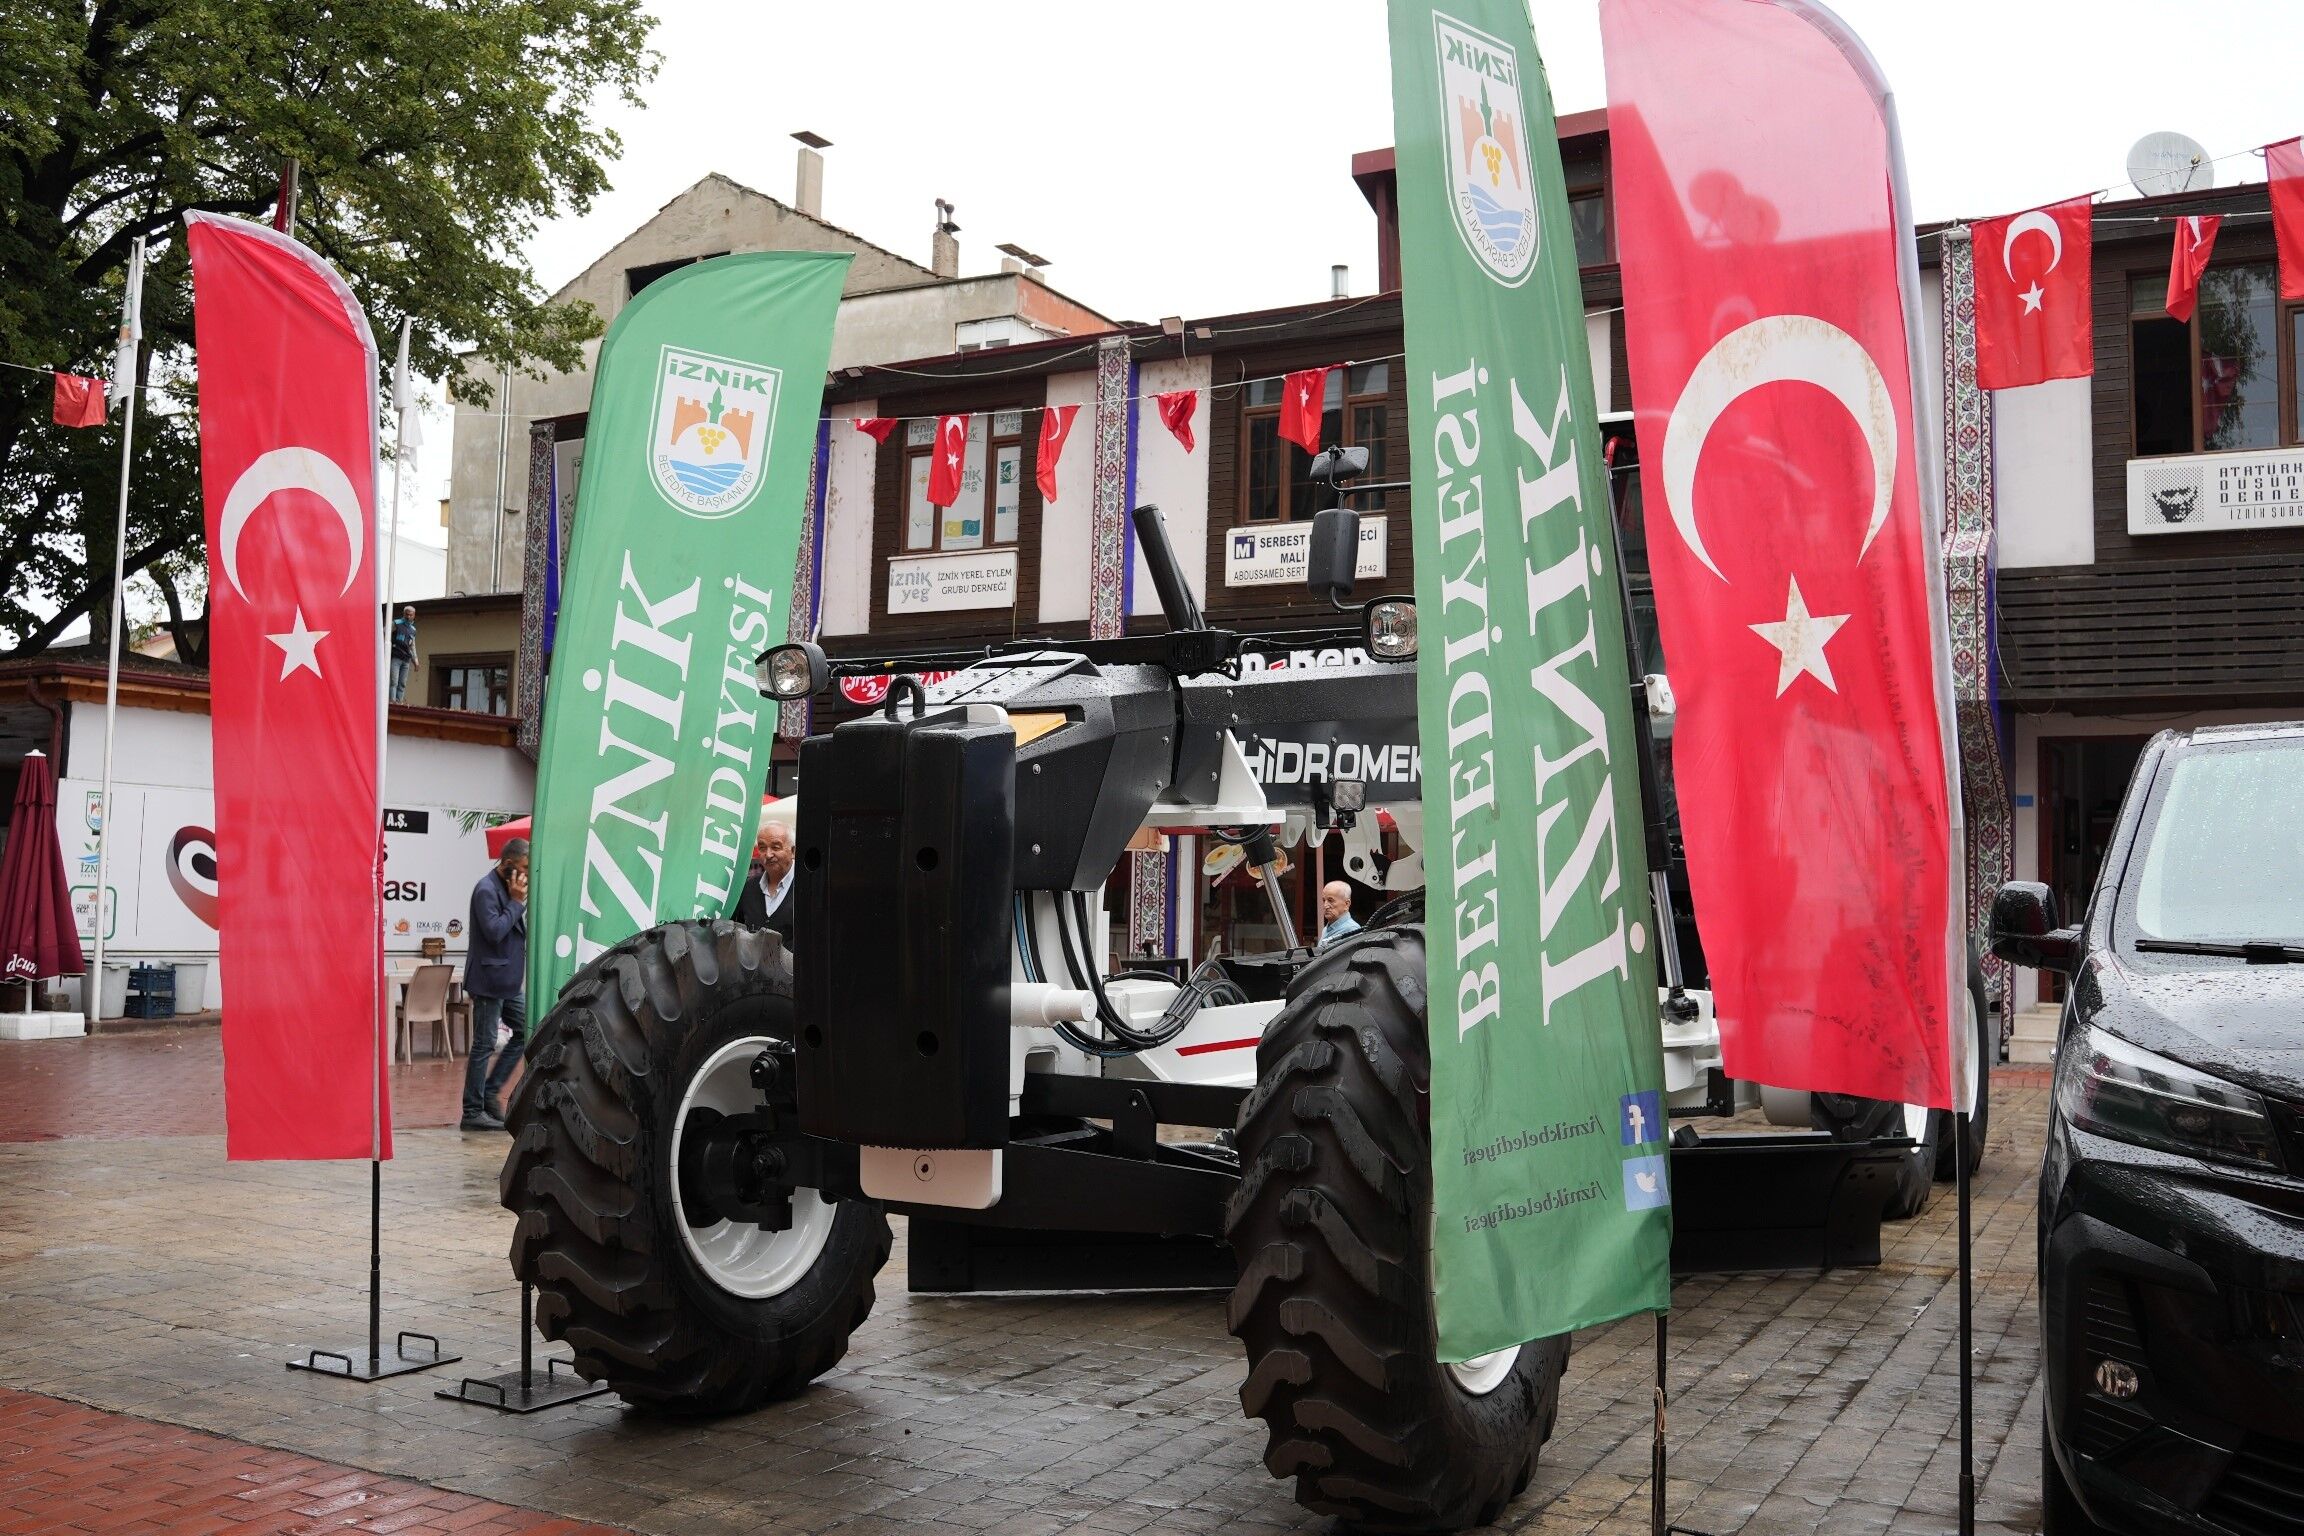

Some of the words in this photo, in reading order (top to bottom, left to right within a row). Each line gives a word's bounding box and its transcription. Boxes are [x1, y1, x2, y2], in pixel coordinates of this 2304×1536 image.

[658, 454, 696, 503] BELEDİYE
[2220, 489, 2299, 503] DERNE
[1260, 534, 1306, 548] SERBEST
[1280, 550, 1305, 564] MALİ
[961, 570, 985, 580] YEREL
[986, 568, 1013, 577] EYLEM
[1286, 566, 1306, 578] SERT
[941, 585, 969, 595] GRUBU
[693, 573, 774, 921] LEDİYESİ
